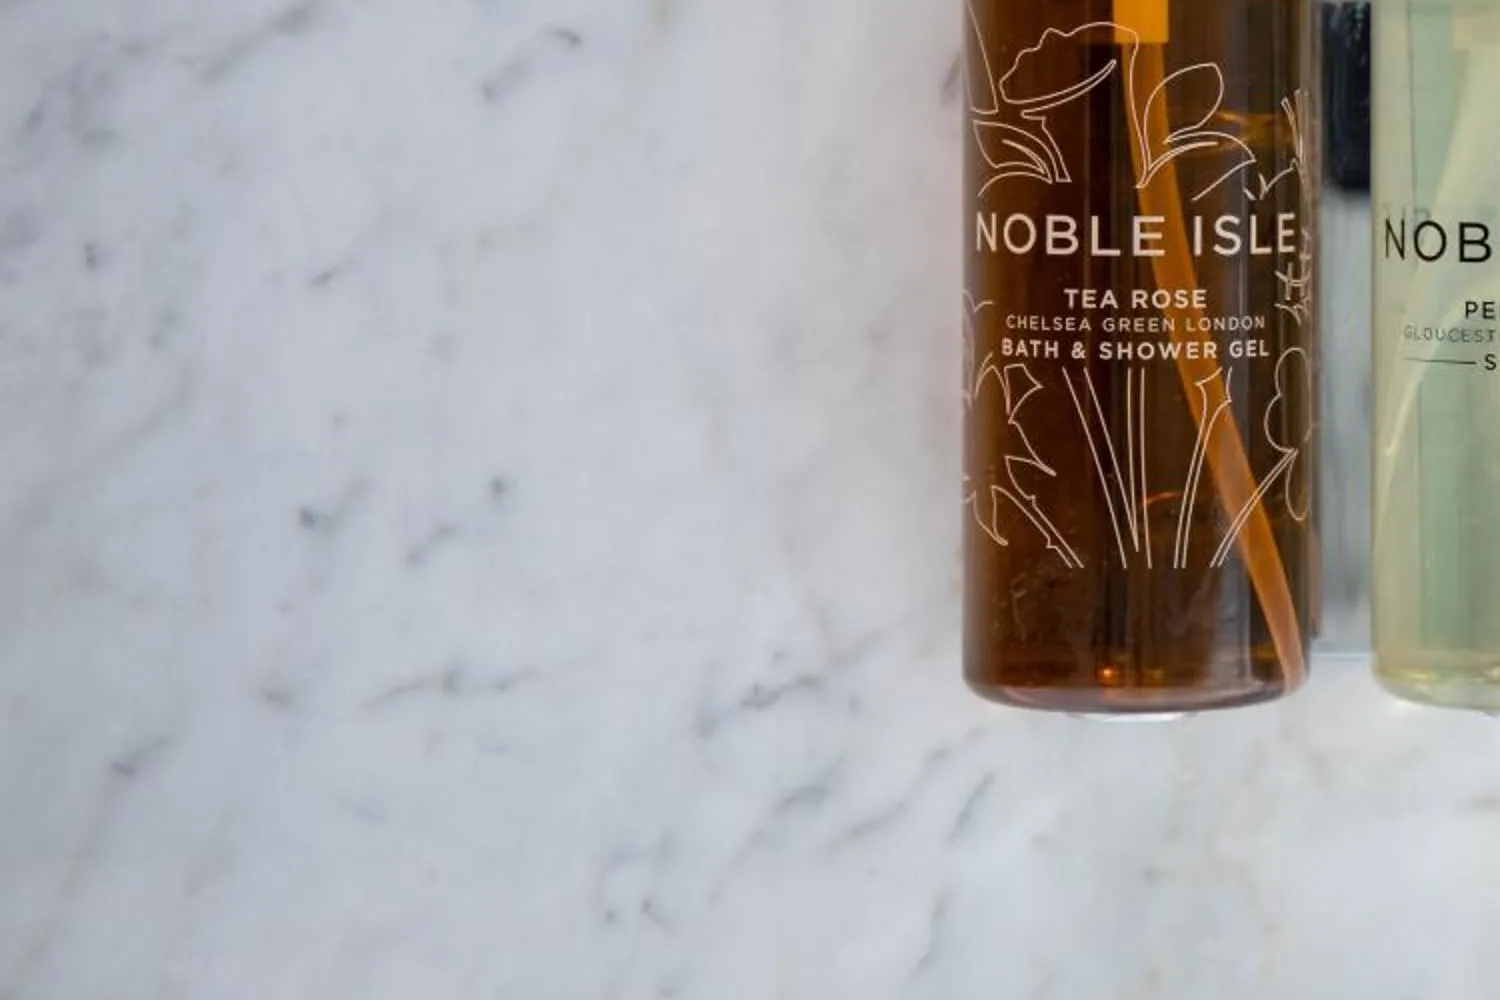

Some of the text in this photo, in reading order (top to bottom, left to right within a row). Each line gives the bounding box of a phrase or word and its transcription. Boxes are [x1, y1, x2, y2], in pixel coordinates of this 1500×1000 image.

[976, 212, 1296, 257] NOBLE ISLE
[1064, 289, 1207, 309] TEA ROSE
[1006, 315, 1266, 333] CHELSEA GREEN LONDON
[1001, 338, 1270, 361] BATH & SHOWER GEL
